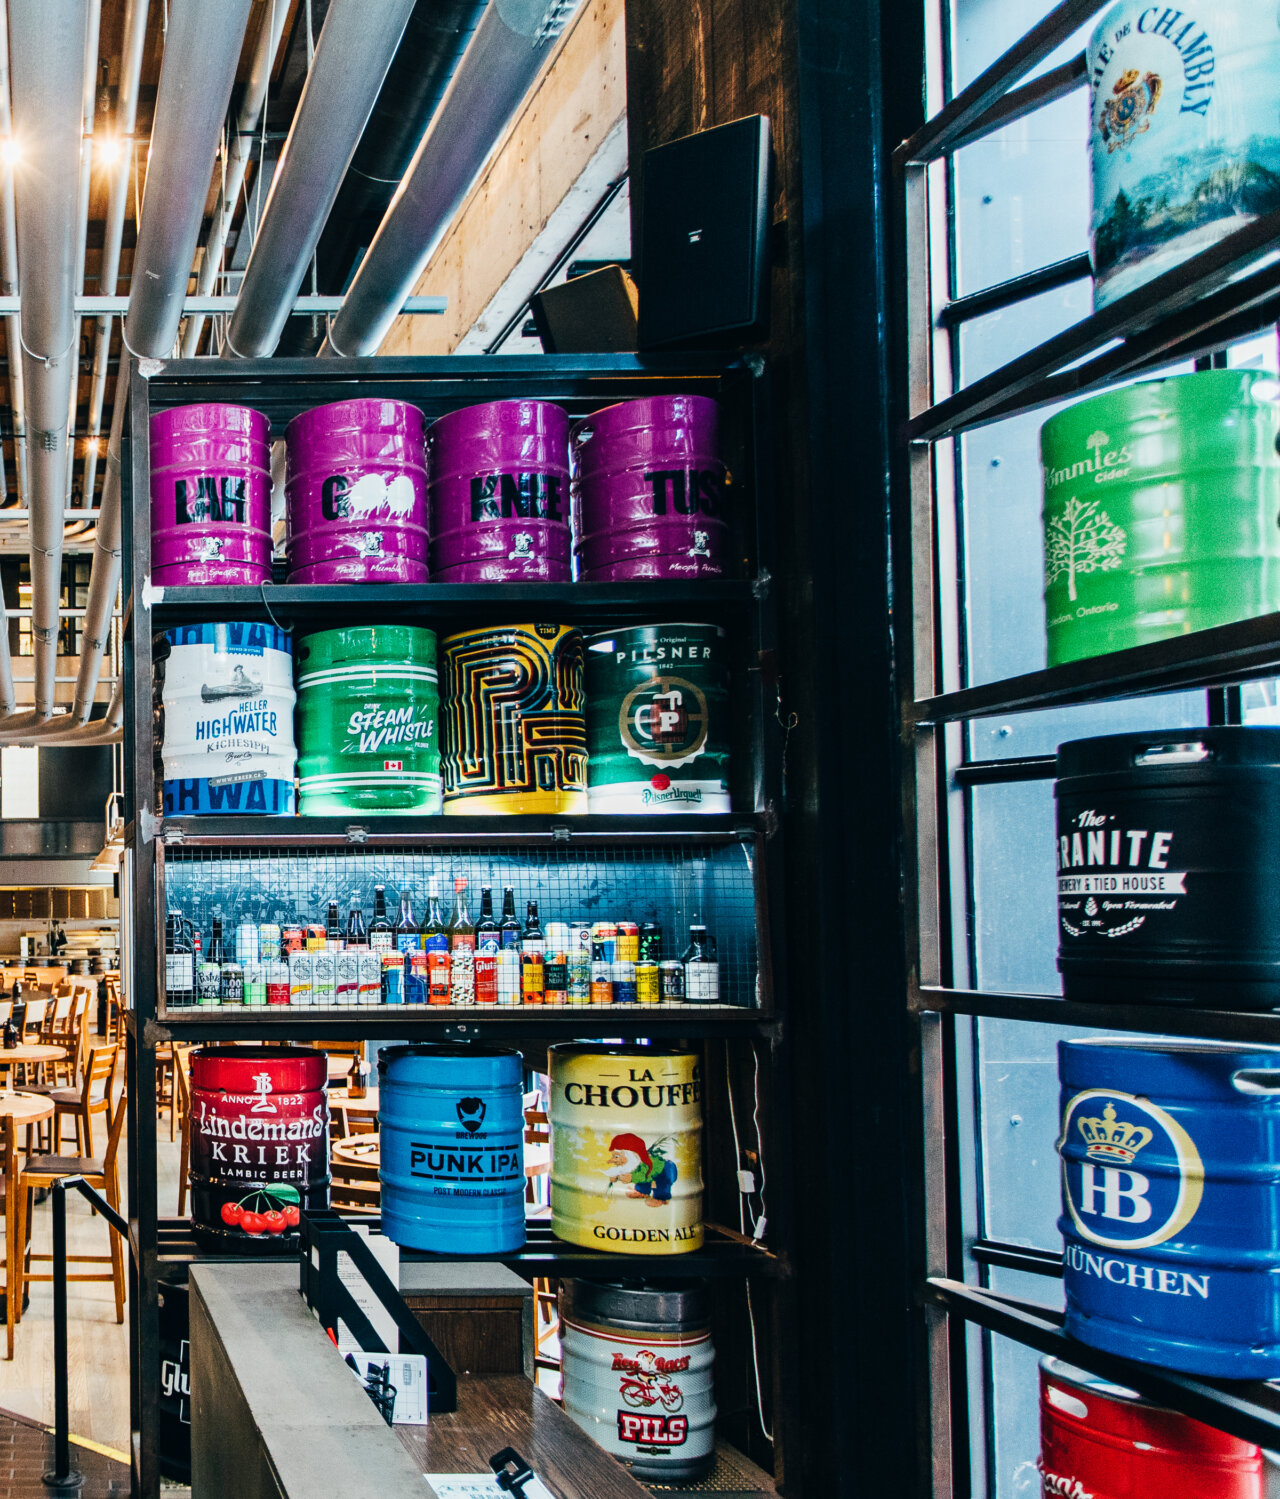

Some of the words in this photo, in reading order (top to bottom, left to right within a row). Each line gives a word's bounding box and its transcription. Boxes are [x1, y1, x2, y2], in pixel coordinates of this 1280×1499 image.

[1115, 22, 1131, 43] DE
[1136, 7, 1215, 116] CHAMBLY
[175, 476, 245, 525] LAH
[470, 473, 563, 522] KNEE
[1076, 602, 1119, 618] Ontario
[616, 646, 711, 664] PILSNER
[239, 699, 268, 713] HELLER
[195, 709, 278, 741] HIGHWATER
[347, 706, 414, 735] STEAM
[359, 720, 434, 754] WHISTLE
[206, 738, 271, 755] KICHESIPPI
[642, 788, 673, 806] Pilsner
[1079, 809, 1106, 828] The
[1084, 877, 1091, 891] &
[1093, 877, 1117, 891] TIED
[1122, 876, 1167, 891] HOUSE
[629, 1069, 655, 1082] LA
[221, 1095, 252, 1105] ANNO
[278, 1095, 303, 1106] 1822
[456, 1132, 488, 1140] BREWDOG
[211, 1141, 312, 1165] KRIEK
[411, 1150, 484, 1173] PUNK
[491, 1153, 519, 1173] IPA
[220, 1167, 267, 1179] LAMBIC
[274, 1170, 303, 1179] BEER
[433, 1187, 451, 1195] POST
[453, 1188, 481, 1197] MODERN
[483, 1188, 506, 1197] CLASSIC
[1080, 1161, 1152, 1224] HB
[593, 1225, 669, 1242] GOLDEN
[674, 1225, 696, 1241] ALE
[622, 1415, 687, 1441] PILS
